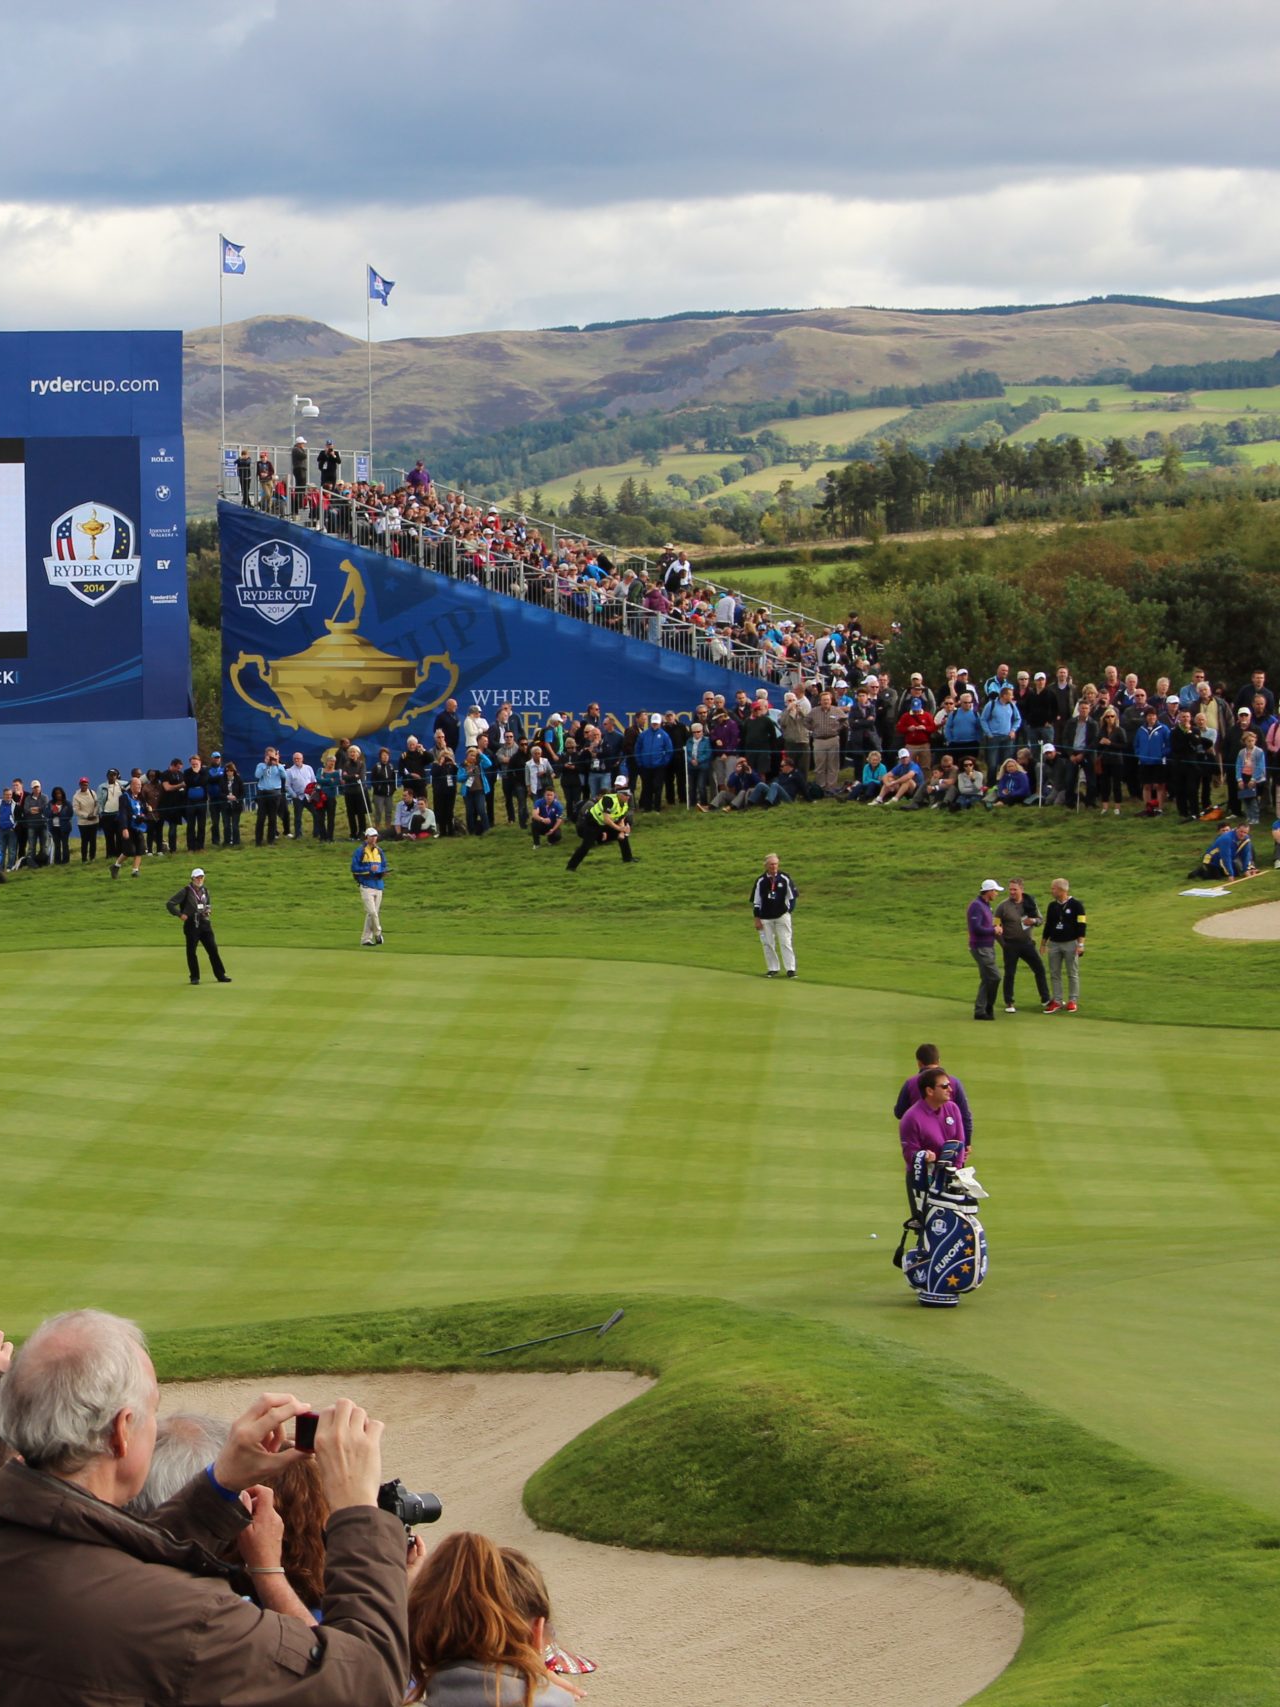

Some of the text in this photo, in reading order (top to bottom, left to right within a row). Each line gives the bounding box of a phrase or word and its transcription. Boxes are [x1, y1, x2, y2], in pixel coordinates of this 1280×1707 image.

[30, 376, 160, 396] rydercup.com
[53, 564, 134, 577] RYDER CUP
[156, 560, 171, 570] EY
[83, 584, 105, 593] 2014
[242, 590, 310, 601] RYDER CUP
[470, 690, 550, 707] WHERE
[934, 1238, 966, 1274] EUROPE
